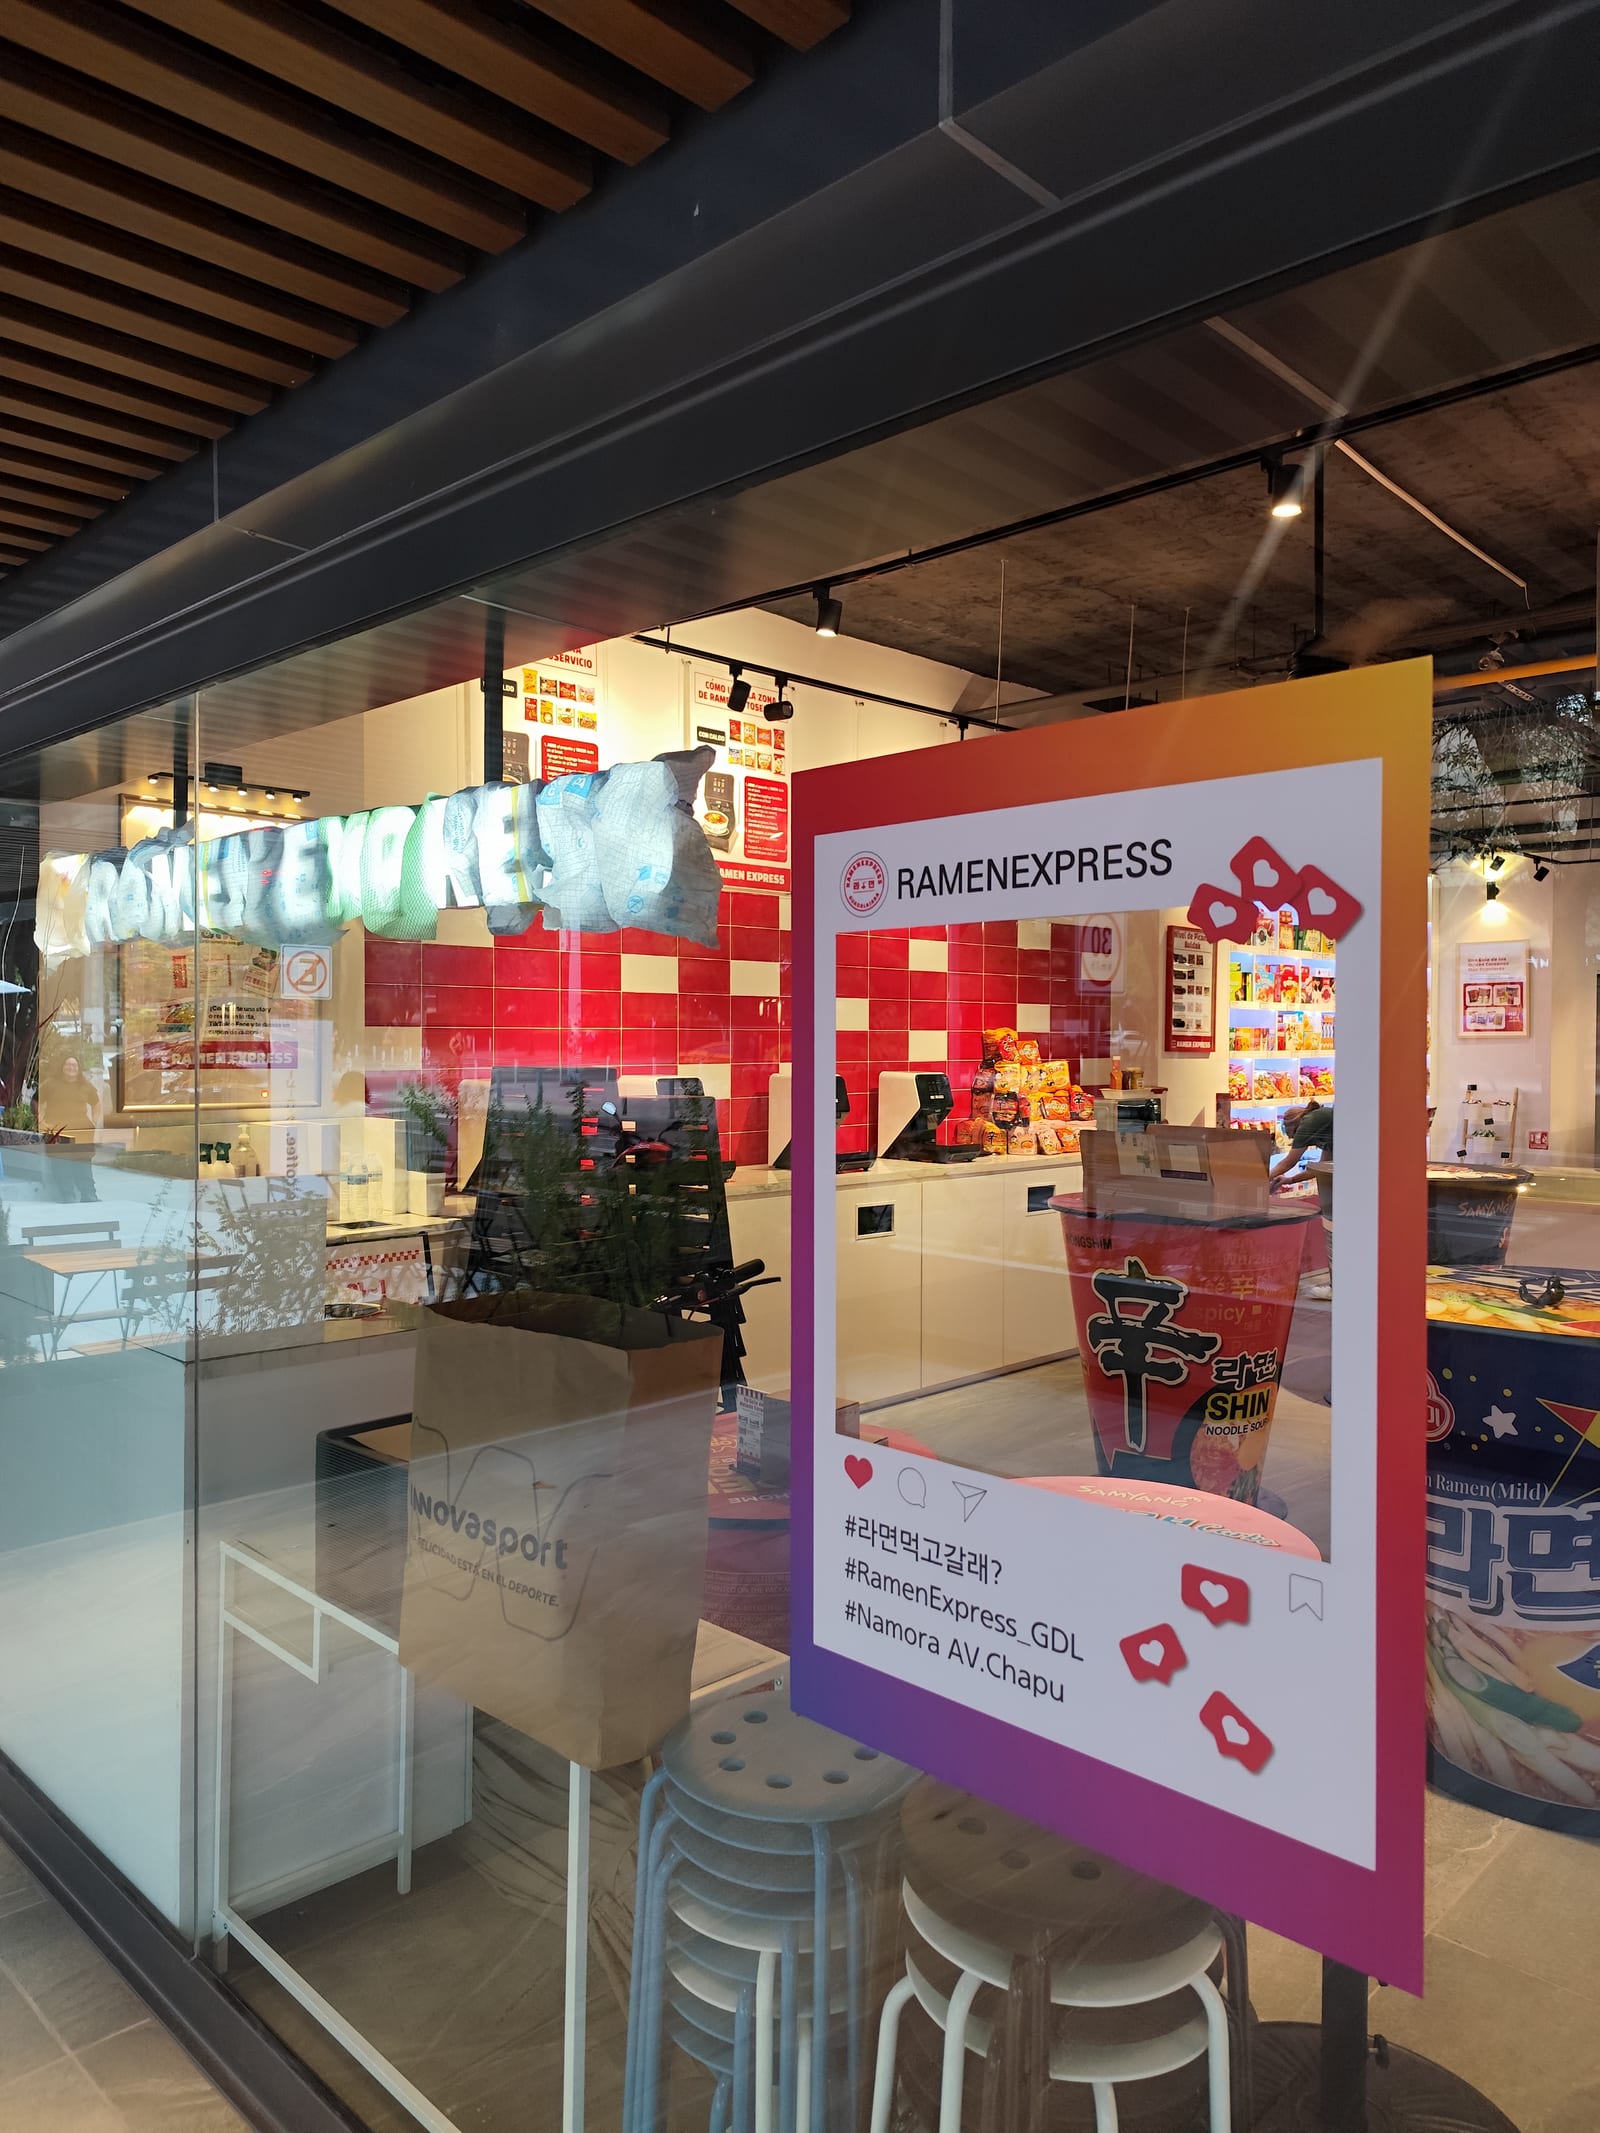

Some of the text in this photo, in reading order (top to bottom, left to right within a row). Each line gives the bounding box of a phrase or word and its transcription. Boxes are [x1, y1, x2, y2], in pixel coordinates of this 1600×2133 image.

[698, 690, 708, 700] DE
[705, 678, 726, 693] CÓMO
[758, 693, 776, 704] ZONA
[720, 868, 785, 885] AMEN EXPRESS
[897, 838, 1173, 900] RAMENEXPRESS
[1211, 1347, 1279, 1391] 라면
[1207, 1388, 1270, 1421] SHIN
[1206, 1424, 1249, 1436] NOODLE
[1077, 1485, 1191, 1509] SAMYANG
[1436, 1473, 1551, 1502] Ramen(Mild)
[845, 1514, 1003, 1585] #라면먹고갈래?
[481, 1569, 495, 1583] EN
[496, 1574, 508, 1588] EL
[845, 1556, 1084, 1662] #RamenExpress_GDL
[845, 1600, 1065, 1703] #Namora AV.Chapu
